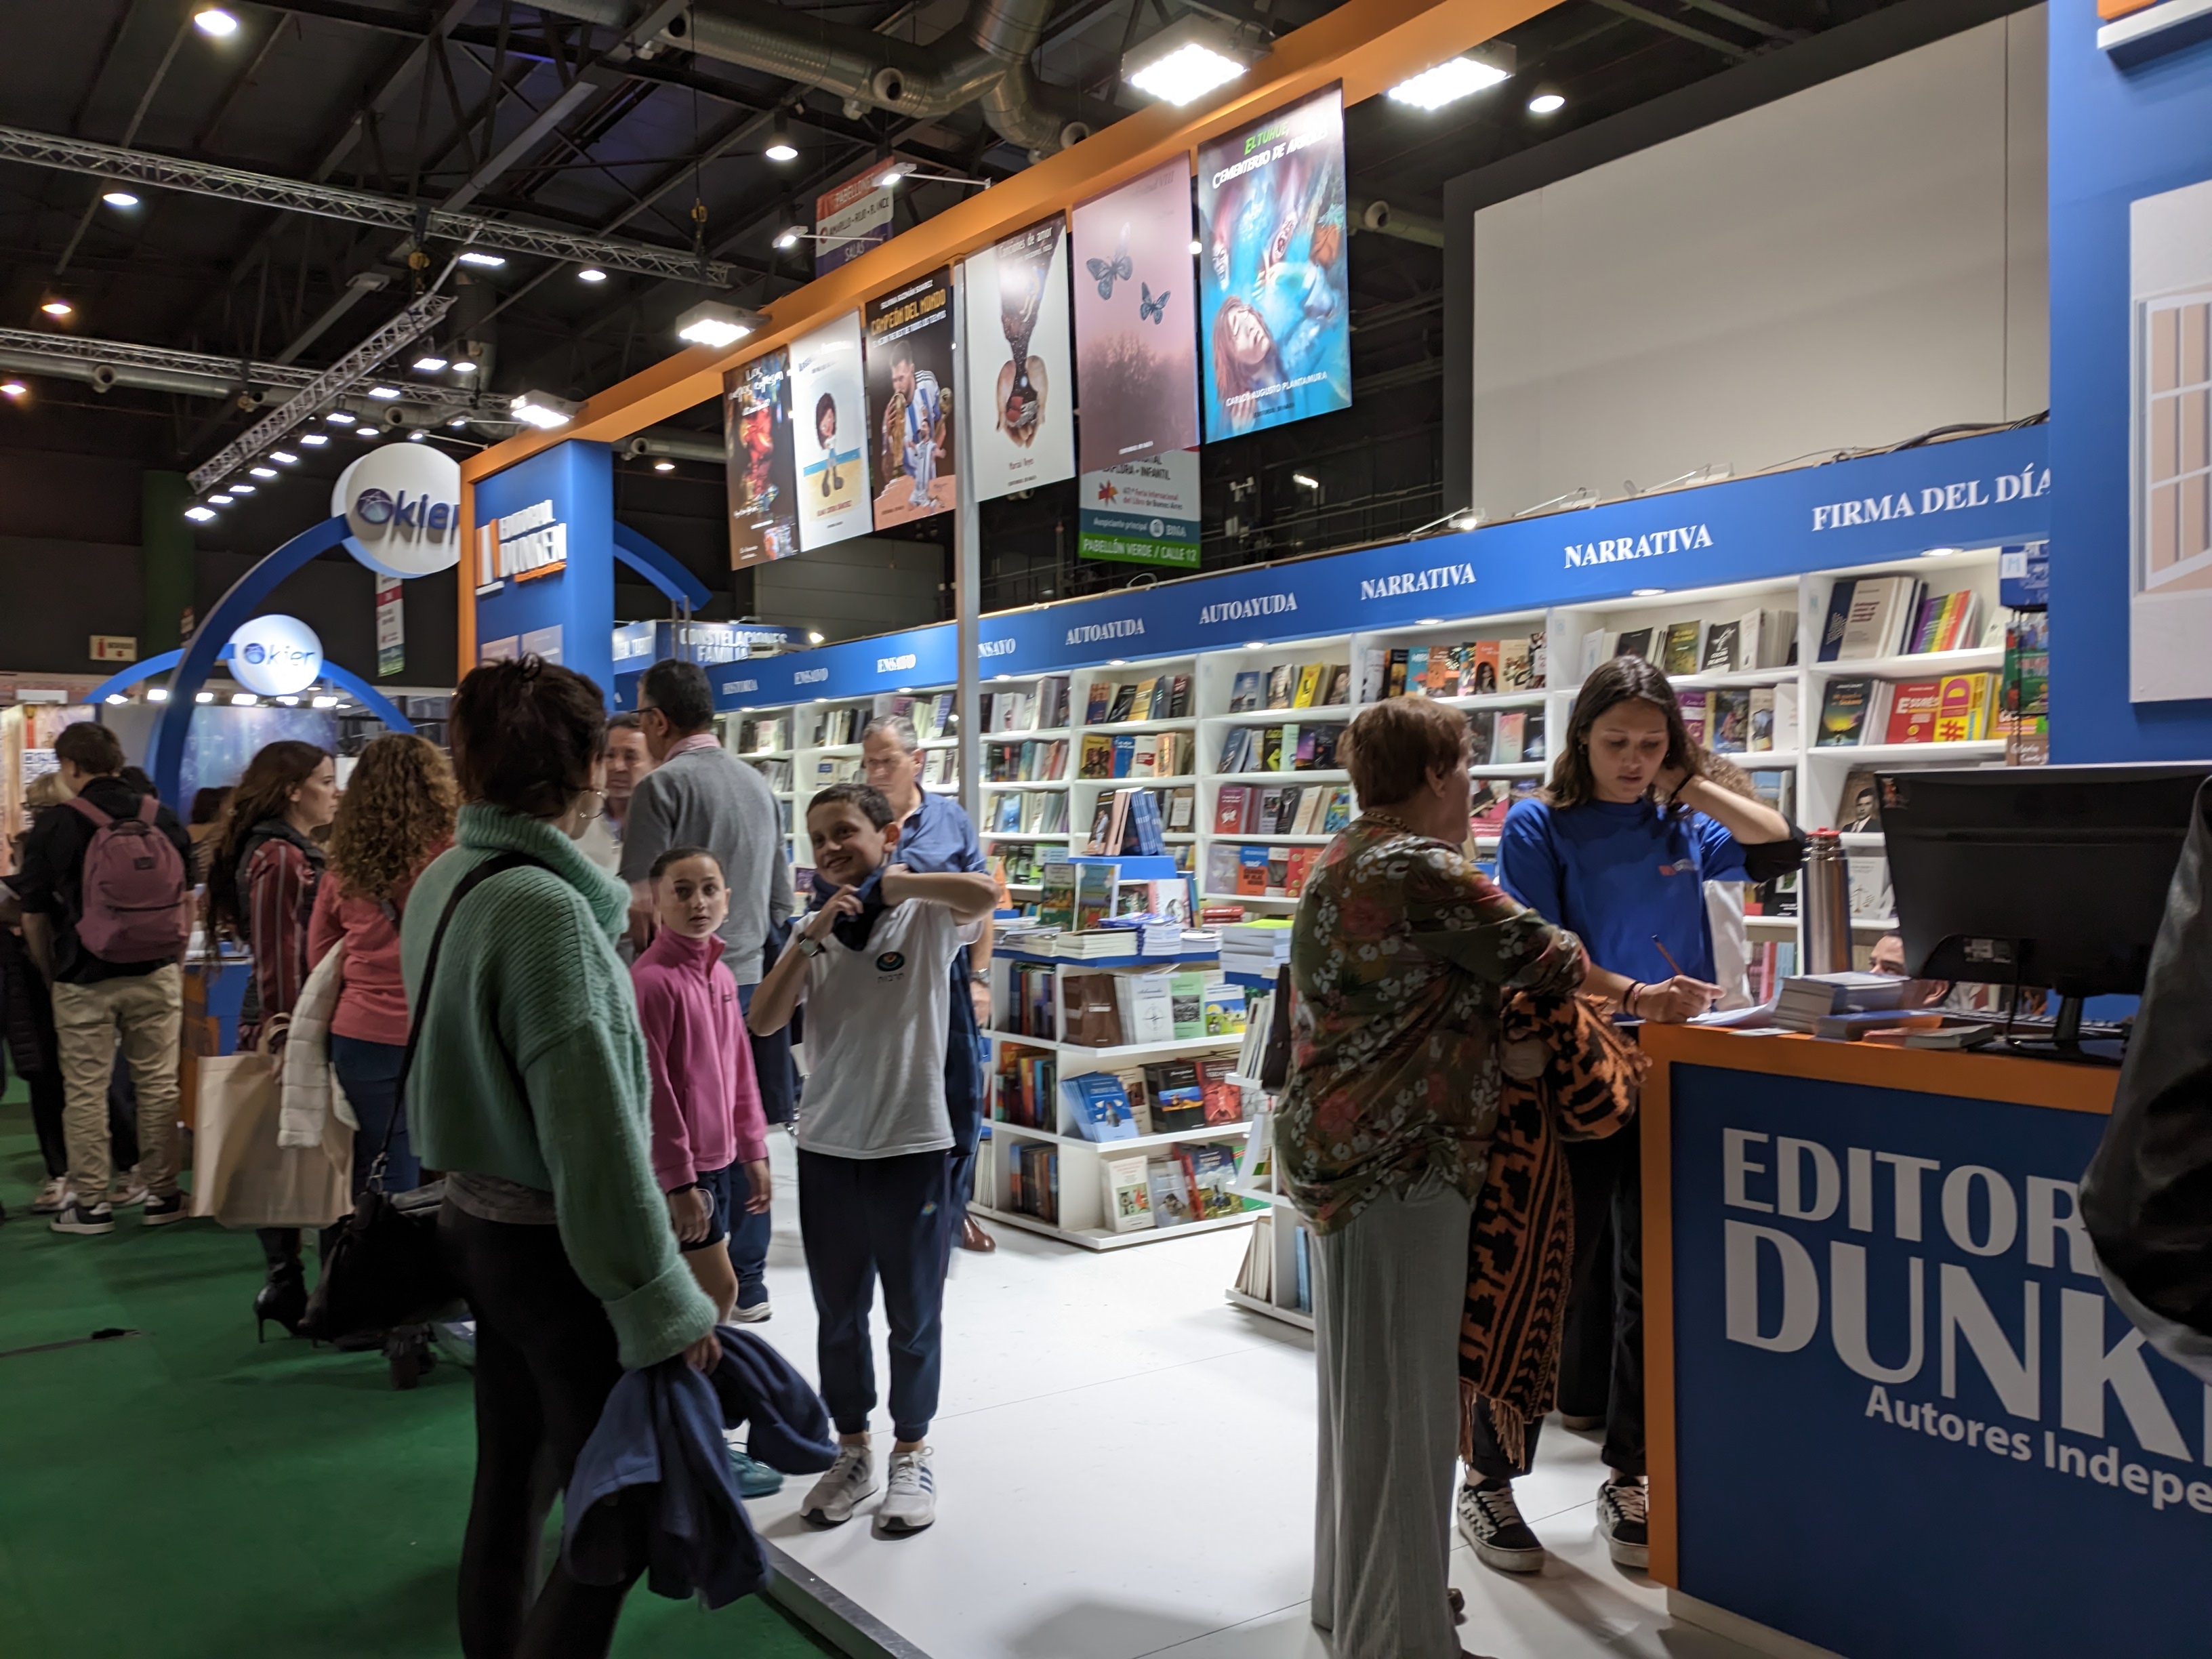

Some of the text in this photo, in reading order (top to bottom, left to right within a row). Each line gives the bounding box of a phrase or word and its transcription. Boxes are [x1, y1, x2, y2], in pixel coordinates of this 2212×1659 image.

[1212, 150, 1271, 189] CEMENTERIO
[1271, 142, 1287, 161] DE
[1027, 232, 1036, 247] de
[1037, 226, 1053, 243] amor
[871, 288, 946, 336] CAMPEÓN DEL MUNDO
[1225, 371, 1328, 407] CARLOS AUGUSTO PLANTAMURA
[1141, 466, 1171, 480] INFANTIL
[1811, 463, 2050, 531] FIRMA DEL DÍA
[1084, 537, 1125, 554] PABELLÓN
[1126, 542, 1152, 558] VERDE
[1160, 546, 1185, 561] CALLE
[1186, 549, 1197, 562] 12
[1563, 523, 1714, 569] NARRATIVA
[1361, 562, 1477, 601] NARRATIVA
[1199, 592, 1298, 625] AUTOAYUDA
[680, 628, 787, 646] CONSTELACIONES
[1065, 617, 1145, 646] AUTOAYUDA
[877, 654, 916, 673] ENSAYO
[722, 679, 758, 695] HISTORIA
[1725, 1218, 2212, 1468] DUNK
[1864, 1384, 2032, 1462] Autores
